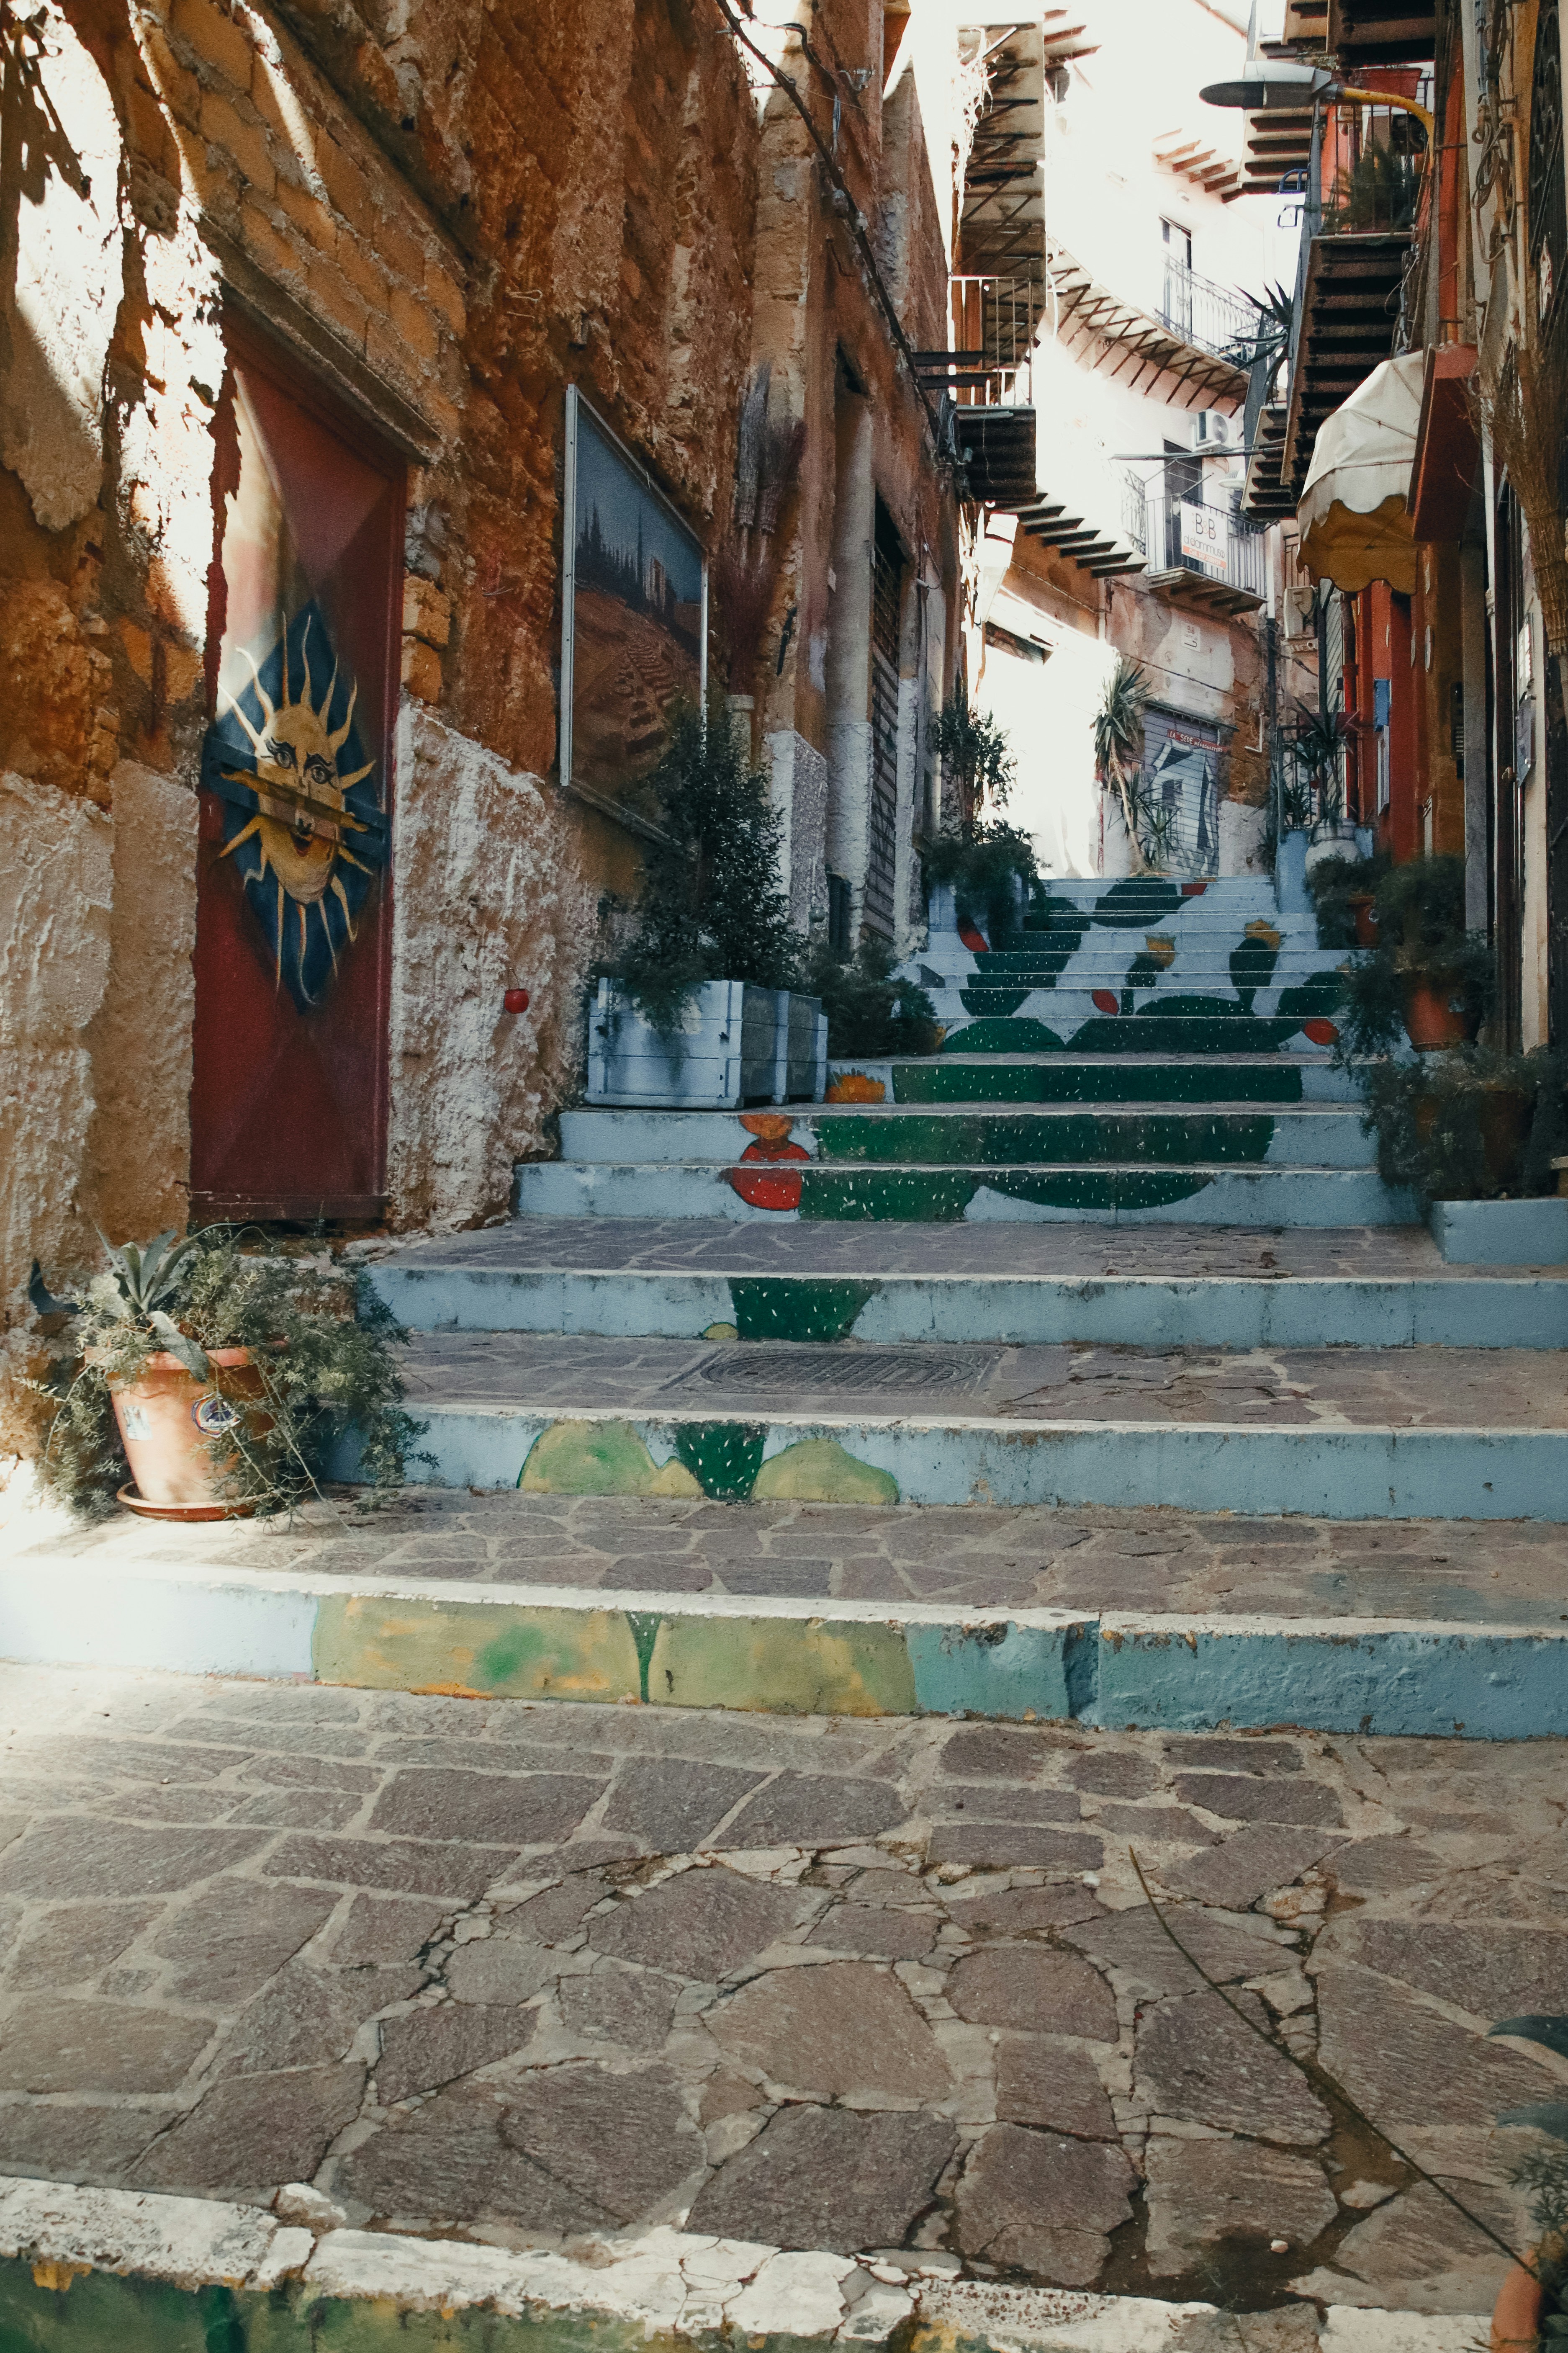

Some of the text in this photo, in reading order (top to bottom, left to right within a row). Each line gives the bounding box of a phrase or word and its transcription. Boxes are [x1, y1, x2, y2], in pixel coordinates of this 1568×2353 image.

[1195, 513, 1216, 540] B&B
[1170, 731, 1175, 739] LA
[1180, 734, 1193, 744] SEDE
